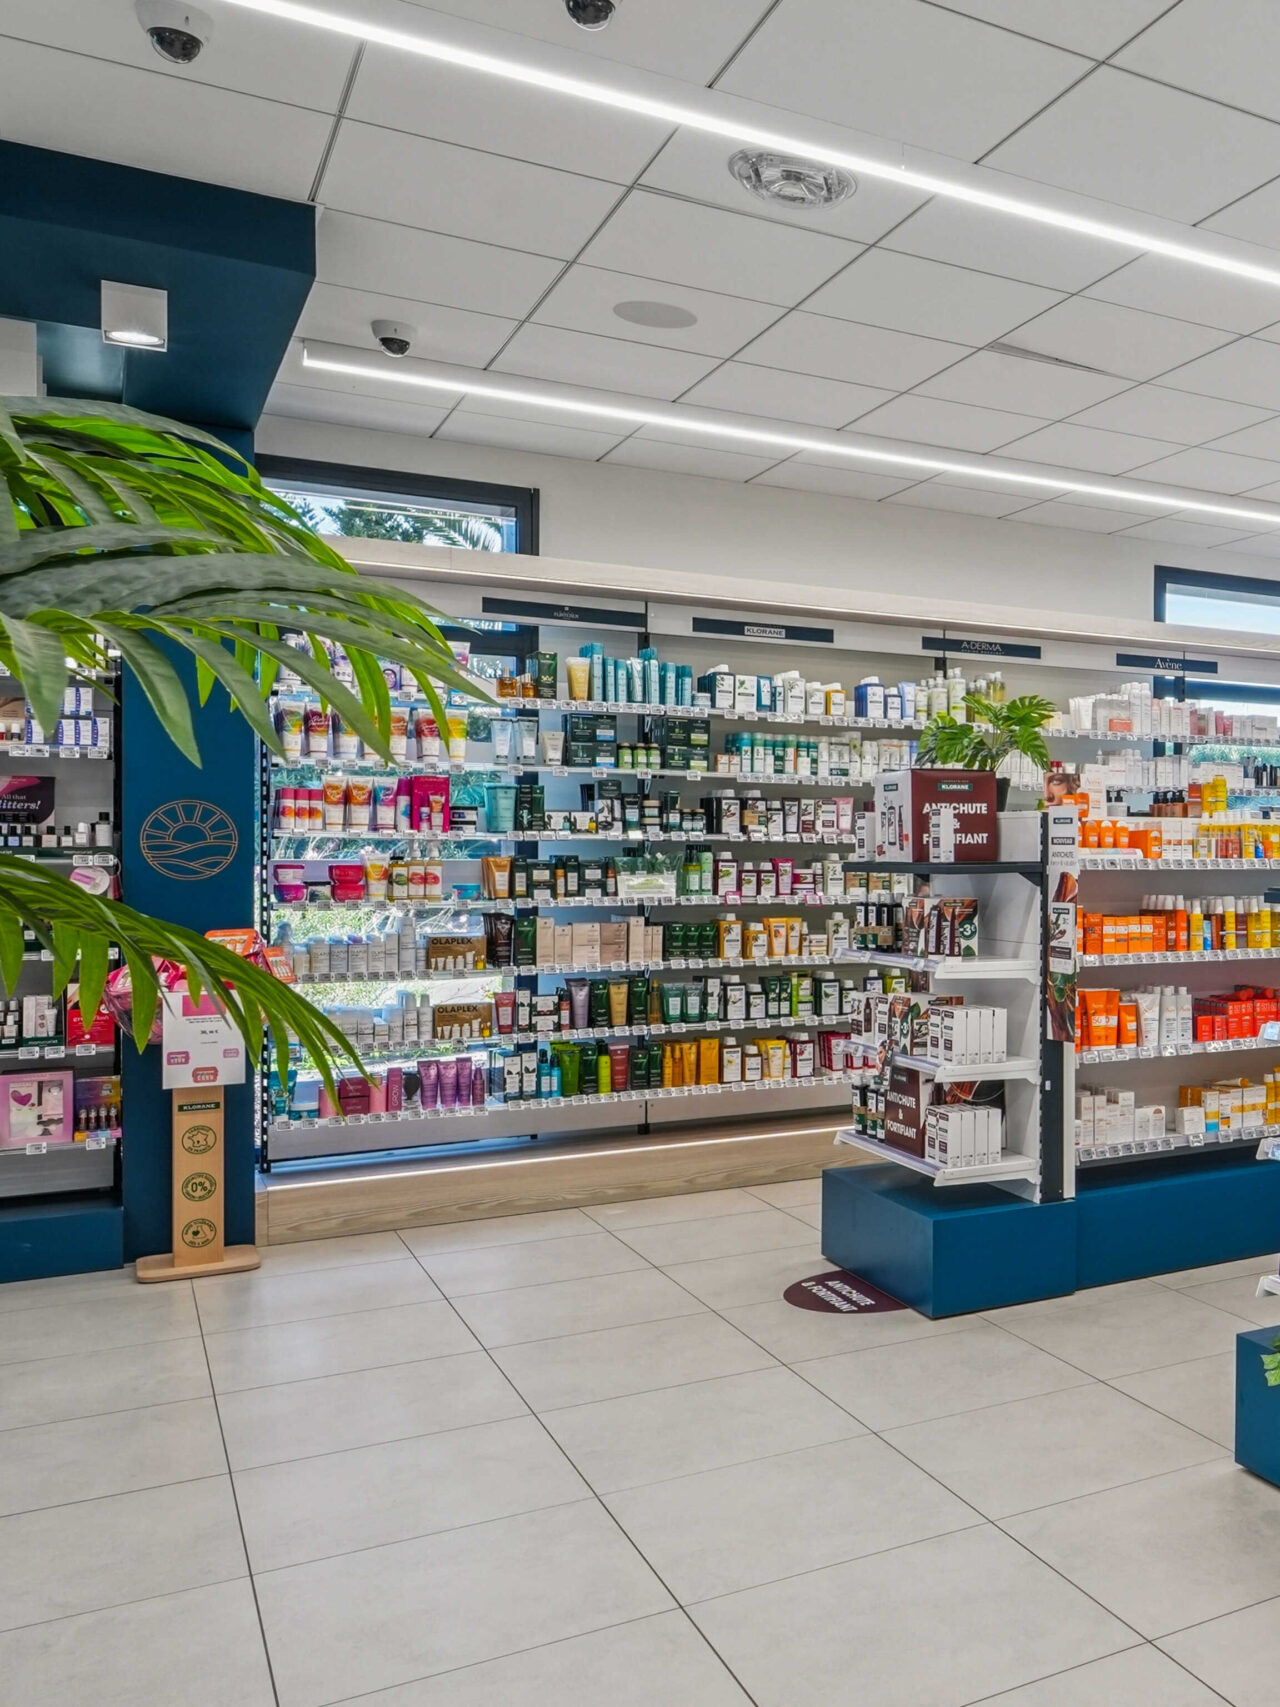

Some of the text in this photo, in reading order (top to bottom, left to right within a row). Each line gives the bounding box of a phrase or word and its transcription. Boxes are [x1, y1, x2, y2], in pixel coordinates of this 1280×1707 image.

[746, 627, 784, 636] KLORANE
[1154, 658, 1182, 670] Avène
[431, 937, 472, 945] OLAPLEX
[437, 1005, 478, 1013] OLAPLEX
[182, 1103, 216, 1111] KLORANE
[191, 1181, 208, 1193] 0%
